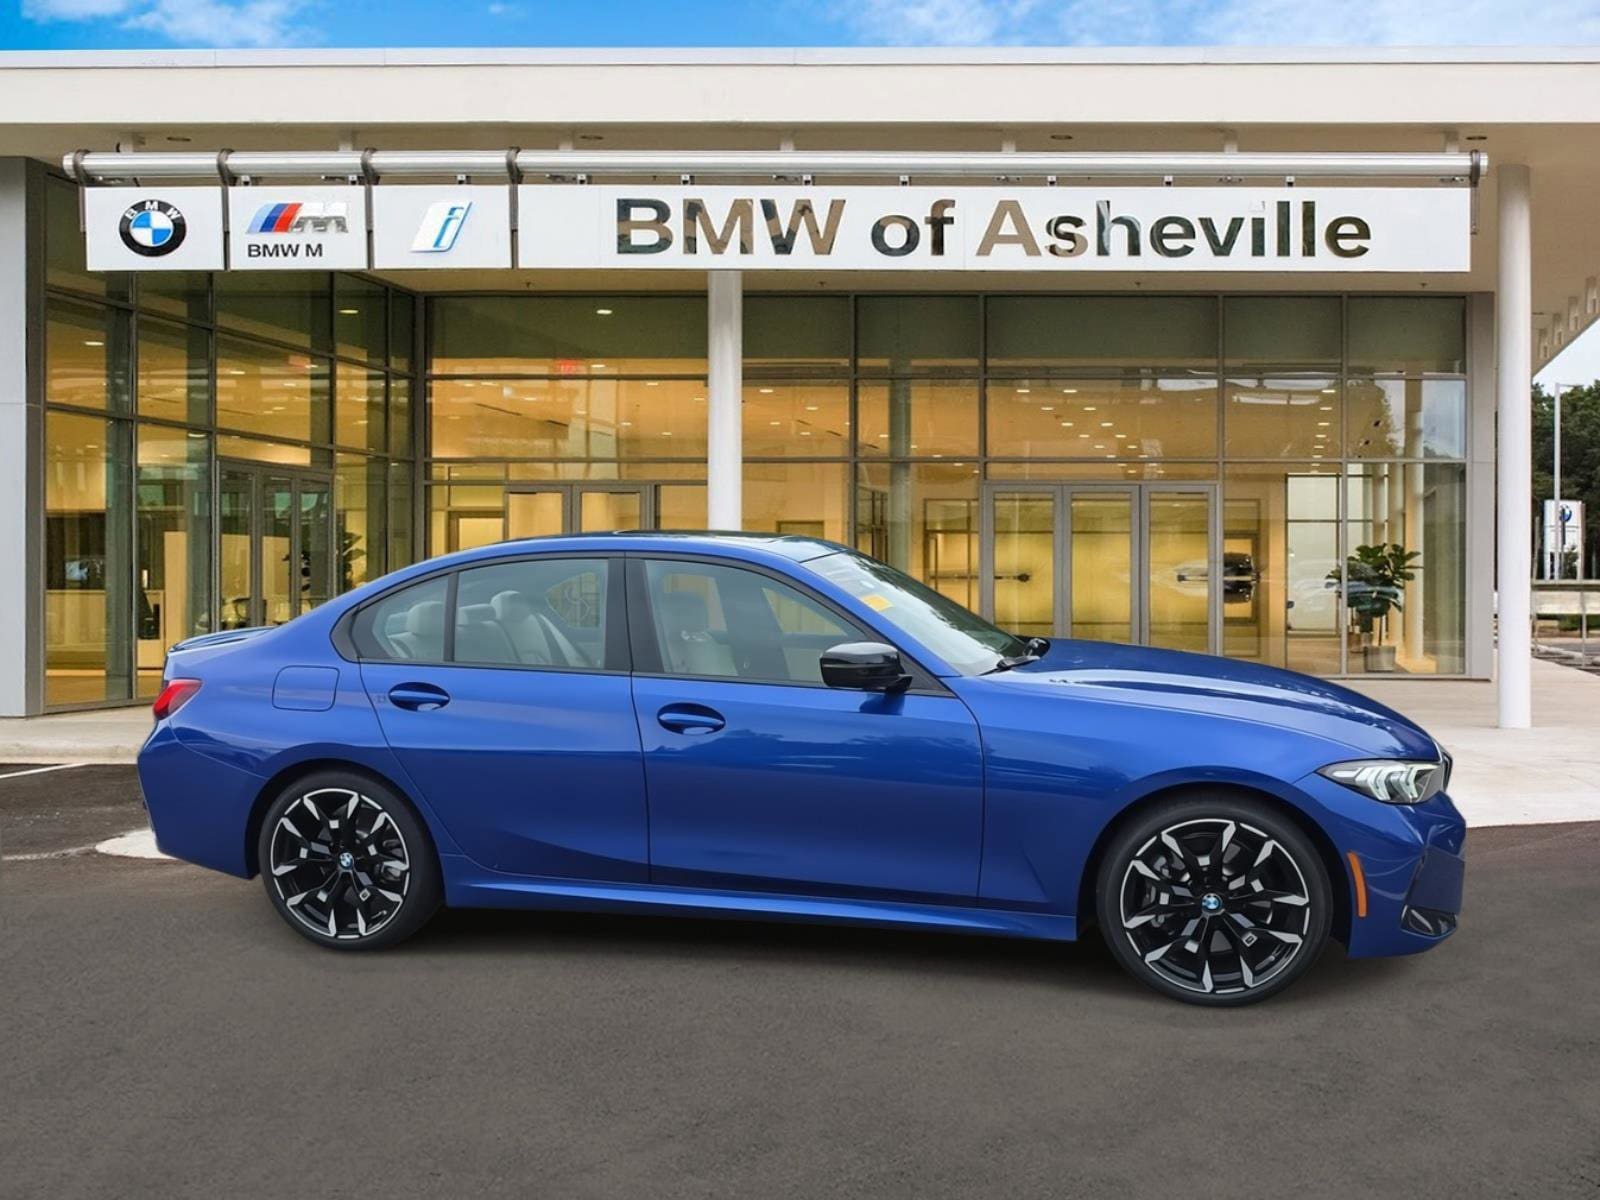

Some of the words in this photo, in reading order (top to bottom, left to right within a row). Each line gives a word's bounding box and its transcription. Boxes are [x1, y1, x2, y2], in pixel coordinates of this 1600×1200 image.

[125, 200, 181, 220] BMW
[615, 197, 847, 256] BMW
[870, 198, 957, 258] of
[974, 198, 1372, 258] Asheville
[247, 243, 300, 258] BMW
[305, 243, 323, 258] M
